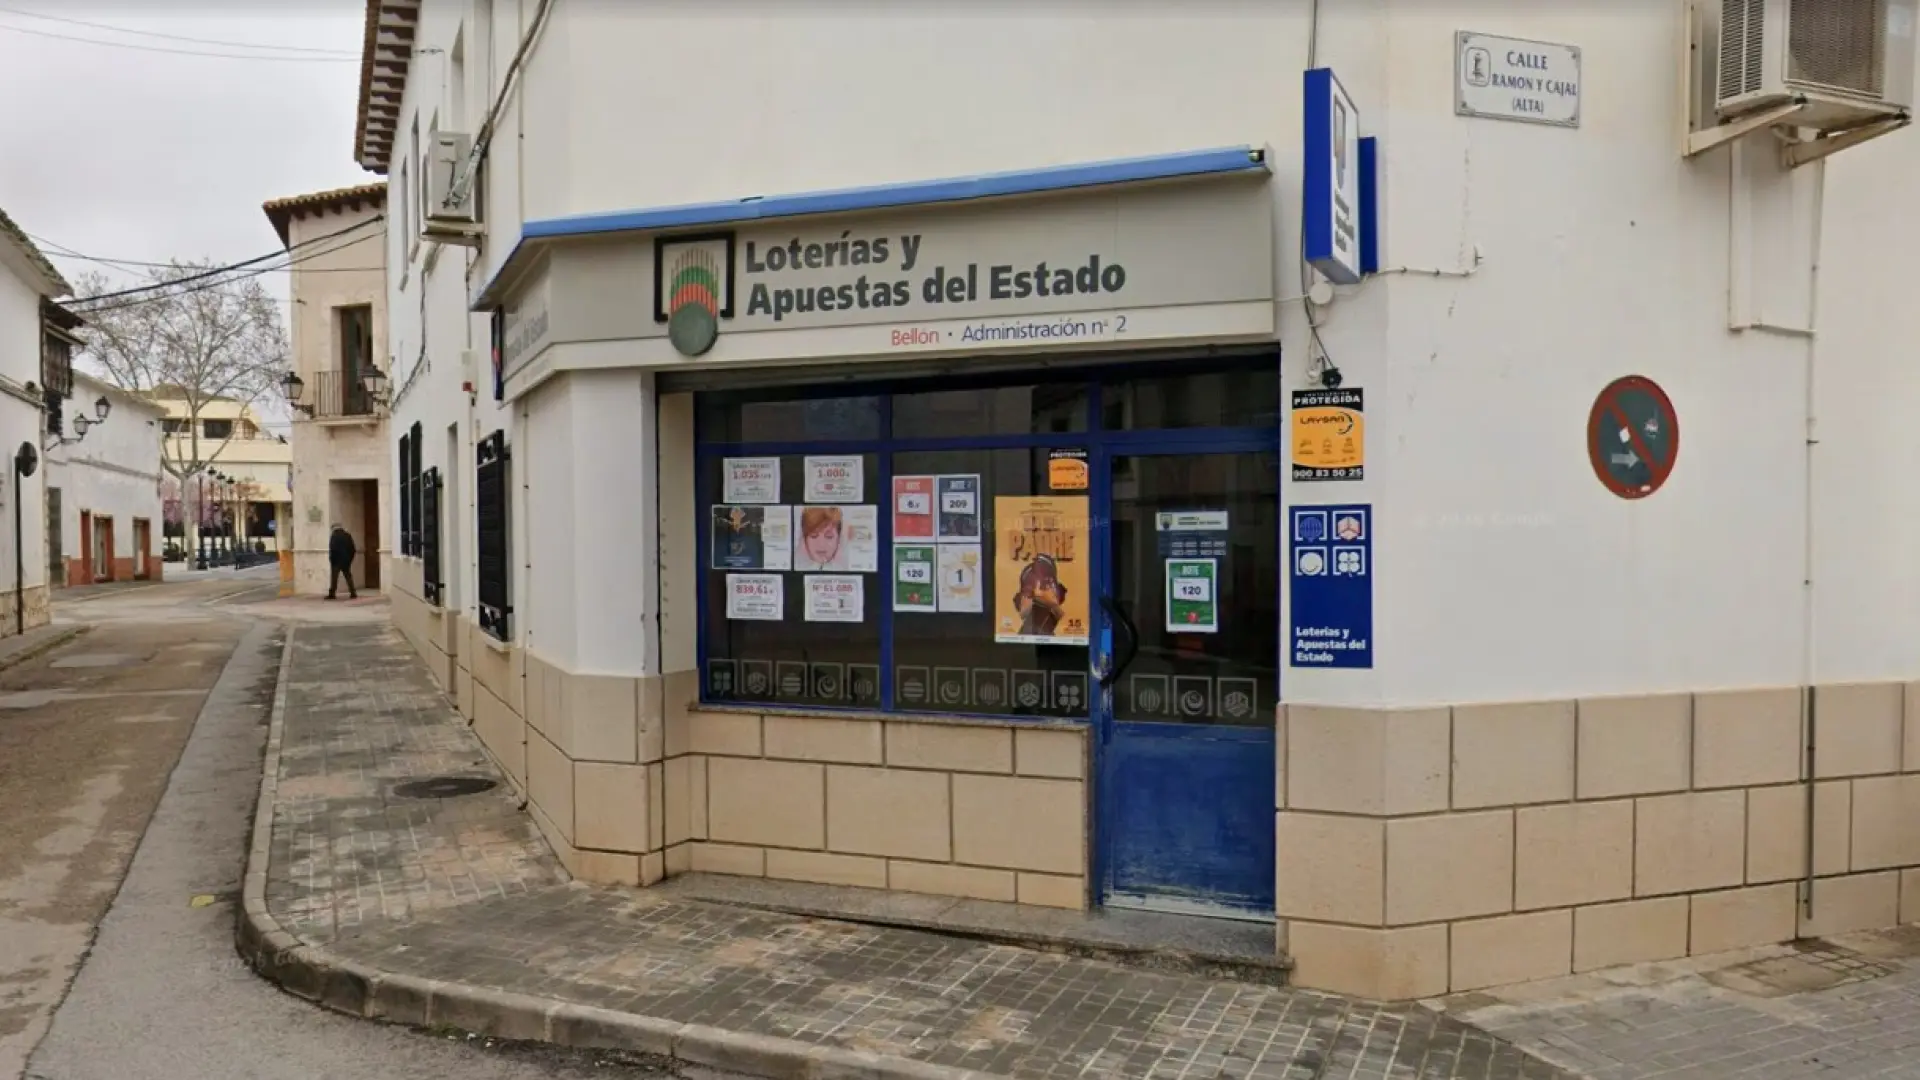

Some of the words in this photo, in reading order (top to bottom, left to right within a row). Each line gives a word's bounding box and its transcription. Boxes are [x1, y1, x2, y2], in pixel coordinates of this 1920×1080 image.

[1506, 50, 1548, 70] CALLE
[1491, 73, 1534, 90] RAMON
[1537, 79, 1544, 92] Y
[1546, 79, 1577, 96] CAJAL
[1512, 97, 1545, 114] (ALTA)
[746, 230, 890, 273] Loterías
[901, 234, 922, 271] y
[747, 274, 911, 321] Apuestas
[922, 264, 977, 304] del
[990, 254, 1126, 300] Estado
[961, 318, 1086, 342] Administración
[1116, 315, 1127, 333] 2
[1294, 395, 1361, 405] PROTEGIDA
[1299, 415, 1345, 425] LAYSAN
[1293, 469, 1313, 479] 900
[1315, 469, 1329, 477] 83
[1332, 469, 1346, 477] 50
[1349, 468, 1362, 477] 25
[955, 567, 964, 583] 1
[1181, 585, 1202, 596] 120
[1295, 626, 1340, 637] Loterías
[1342, 629, 1350, 639] y
[1296, 639, 1347, 651] Apuestas
[1348, 639, 1366, 650] del
[1296, 651, 1334, 662] Estado
